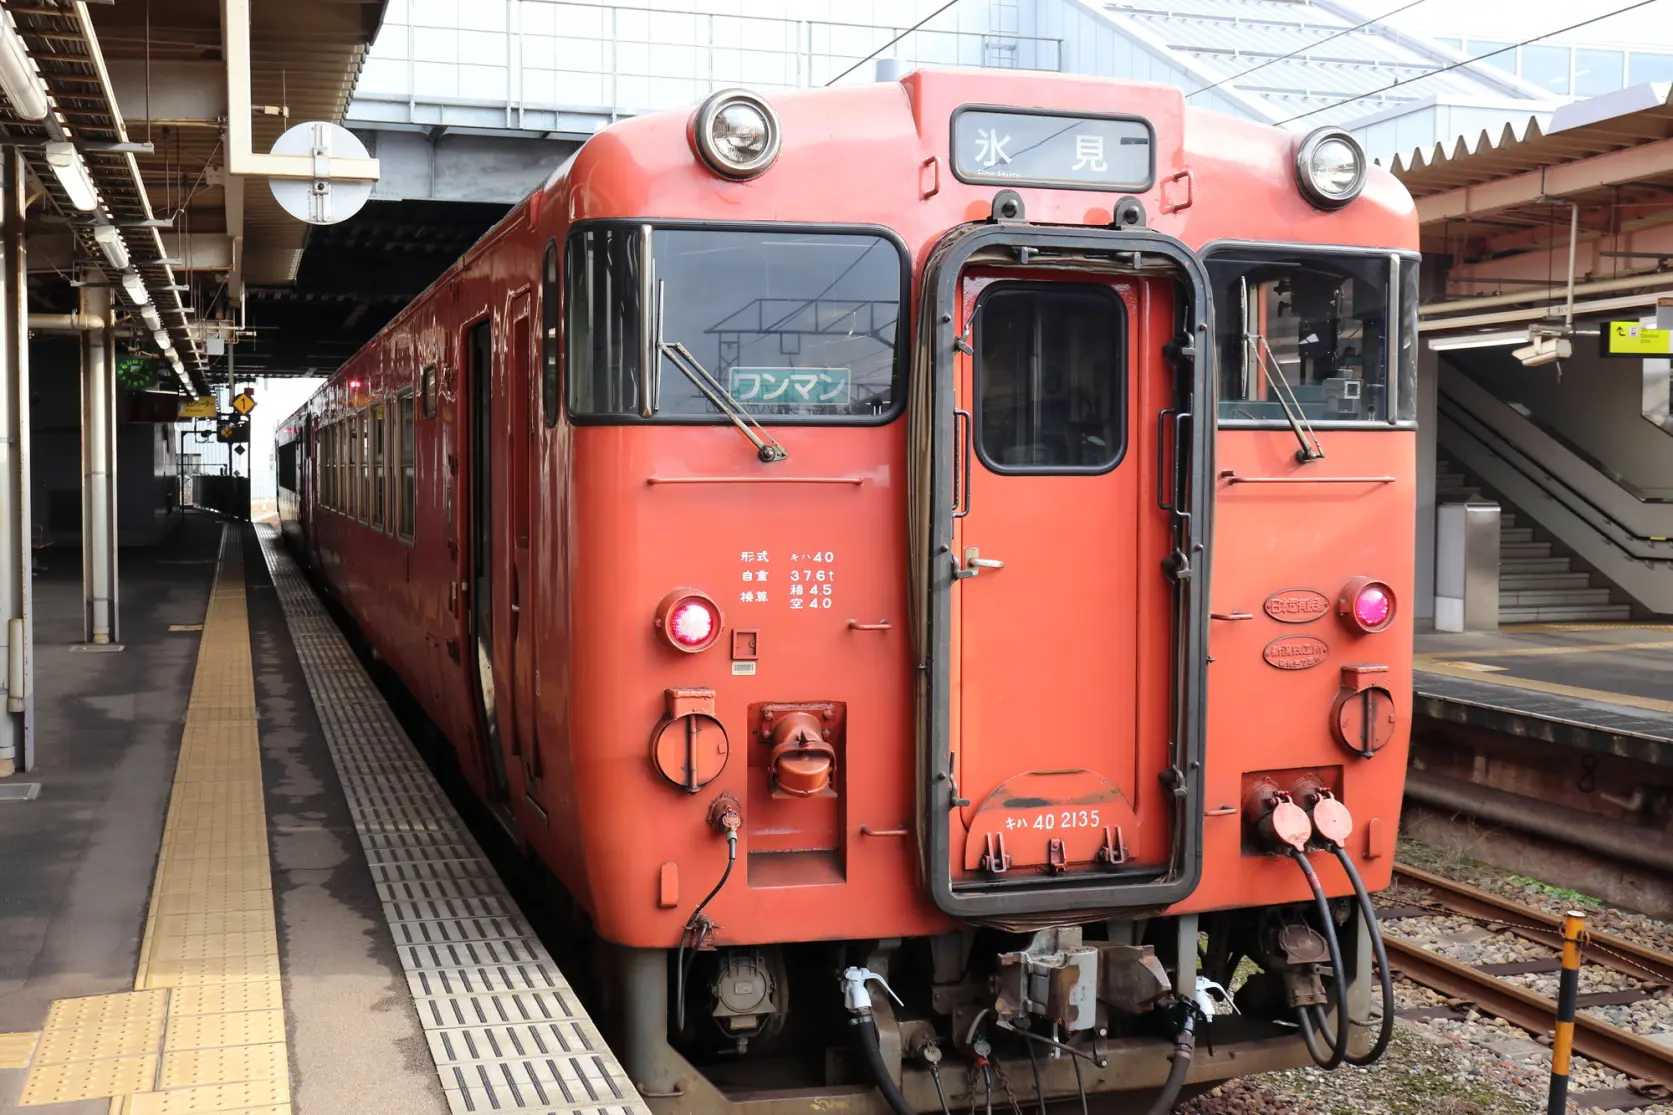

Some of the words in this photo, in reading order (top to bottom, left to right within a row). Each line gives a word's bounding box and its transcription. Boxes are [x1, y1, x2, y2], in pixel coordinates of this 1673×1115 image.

[974, 128, 1108, 172] 氷見
[734, 373, 846, 400] ワンマン
[741, 550, 769, 562] 形式
[742, 570, 769, 582] 自重
[740, 591, 768, 602] 換算
[1005, 817, 1028, 830] キハ
[1032, 813, 1055, 830] 40
[1061, 810, 1100, 828] 2135
